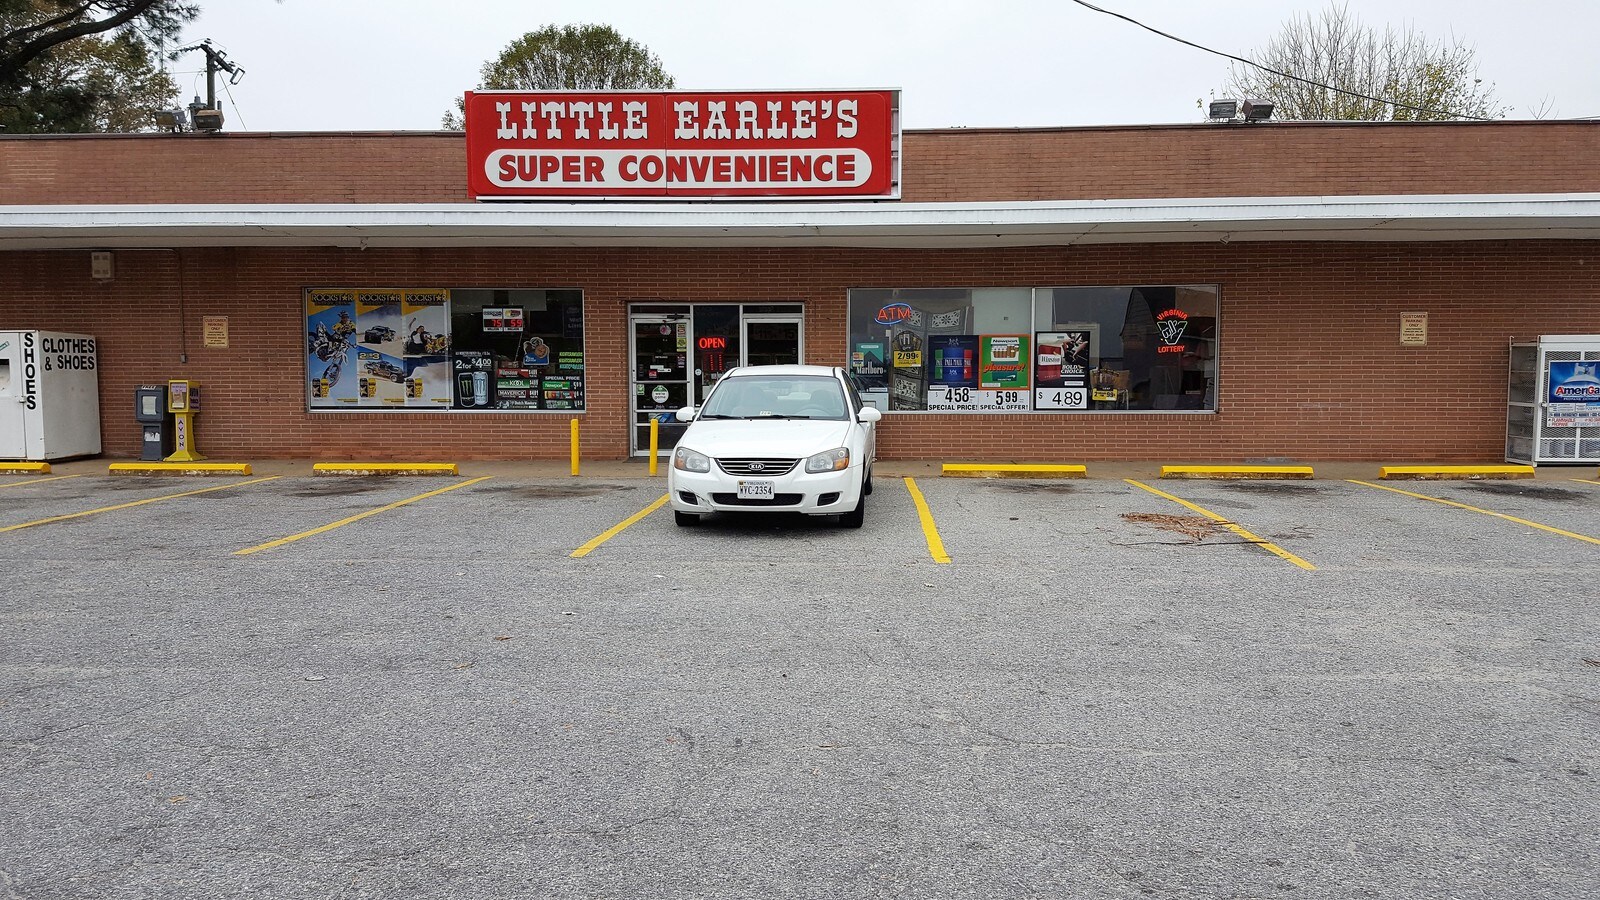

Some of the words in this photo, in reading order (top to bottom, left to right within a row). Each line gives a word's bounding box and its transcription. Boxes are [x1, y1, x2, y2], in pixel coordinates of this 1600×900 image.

[495, 101, 648, 140] LITTLE
[673, 99, 859, 139] EARLE'S
[498, 154, 605, 182] SUPER
[618, 154, 856, 183] CONVENIENCE
[877, 307, 911, 320] ATM
[1157, 309, 1188, 320] VIRGINIA
[42, 338, 95, 354] CLOTHES
[699, 337, 725, 349] OPEN
[1157, 345, 1185, 353] LOTTERY
[44, 356, 52, 371] &
[57, 355, 95, 370] SHOES
[24, 333, 36, 410] SHOES
